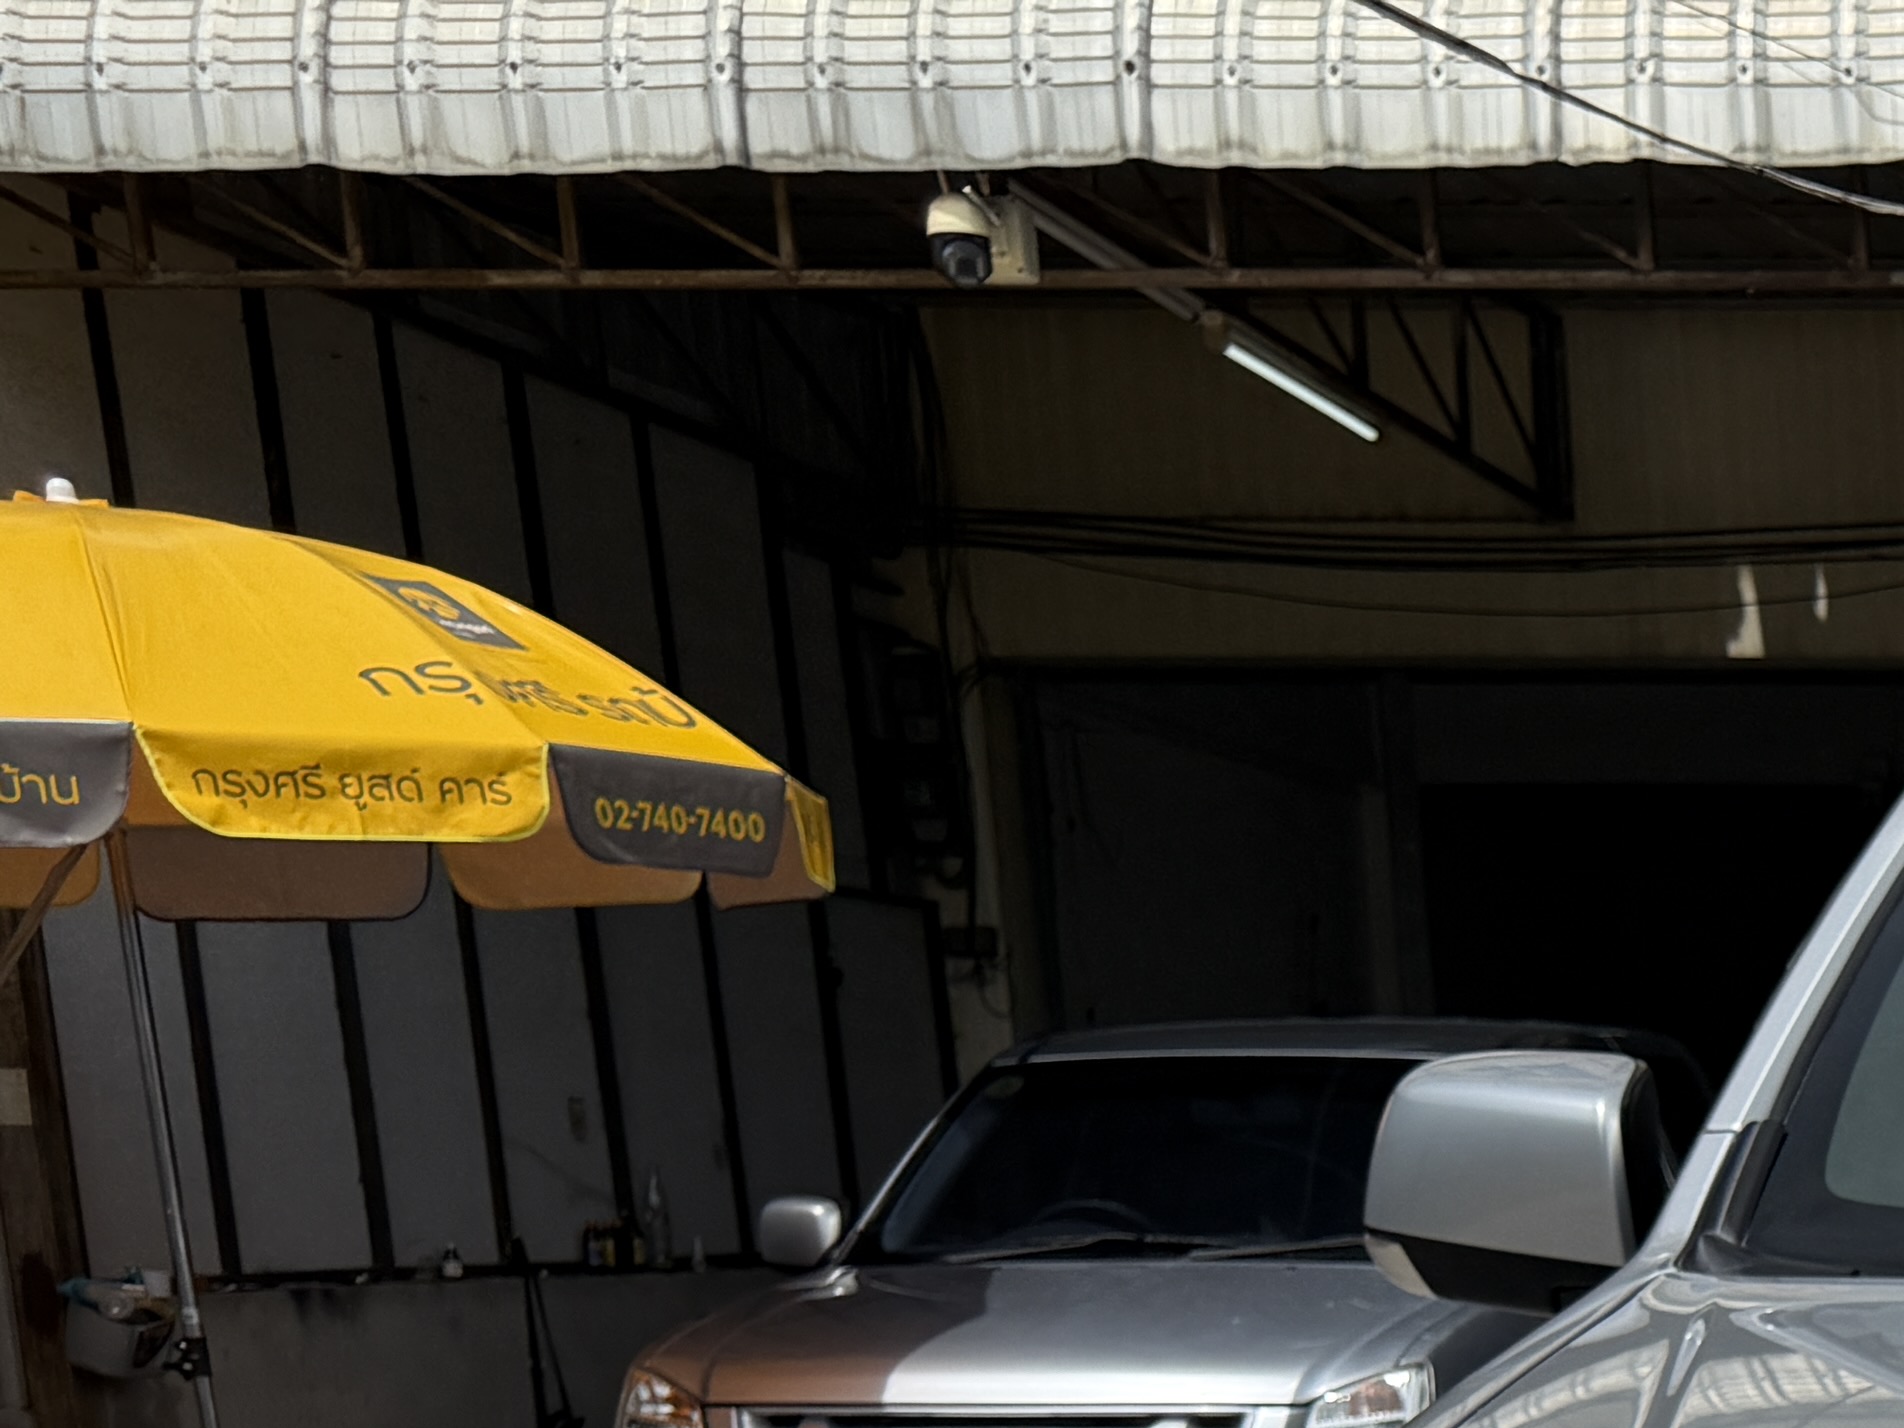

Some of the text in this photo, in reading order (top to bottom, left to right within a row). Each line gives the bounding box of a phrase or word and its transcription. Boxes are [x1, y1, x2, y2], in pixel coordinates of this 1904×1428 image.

[191, 763, 513, 812] กรุงศรี ยูสด์ คาร์
[594, 796, 766, 843] 02-740-7400
